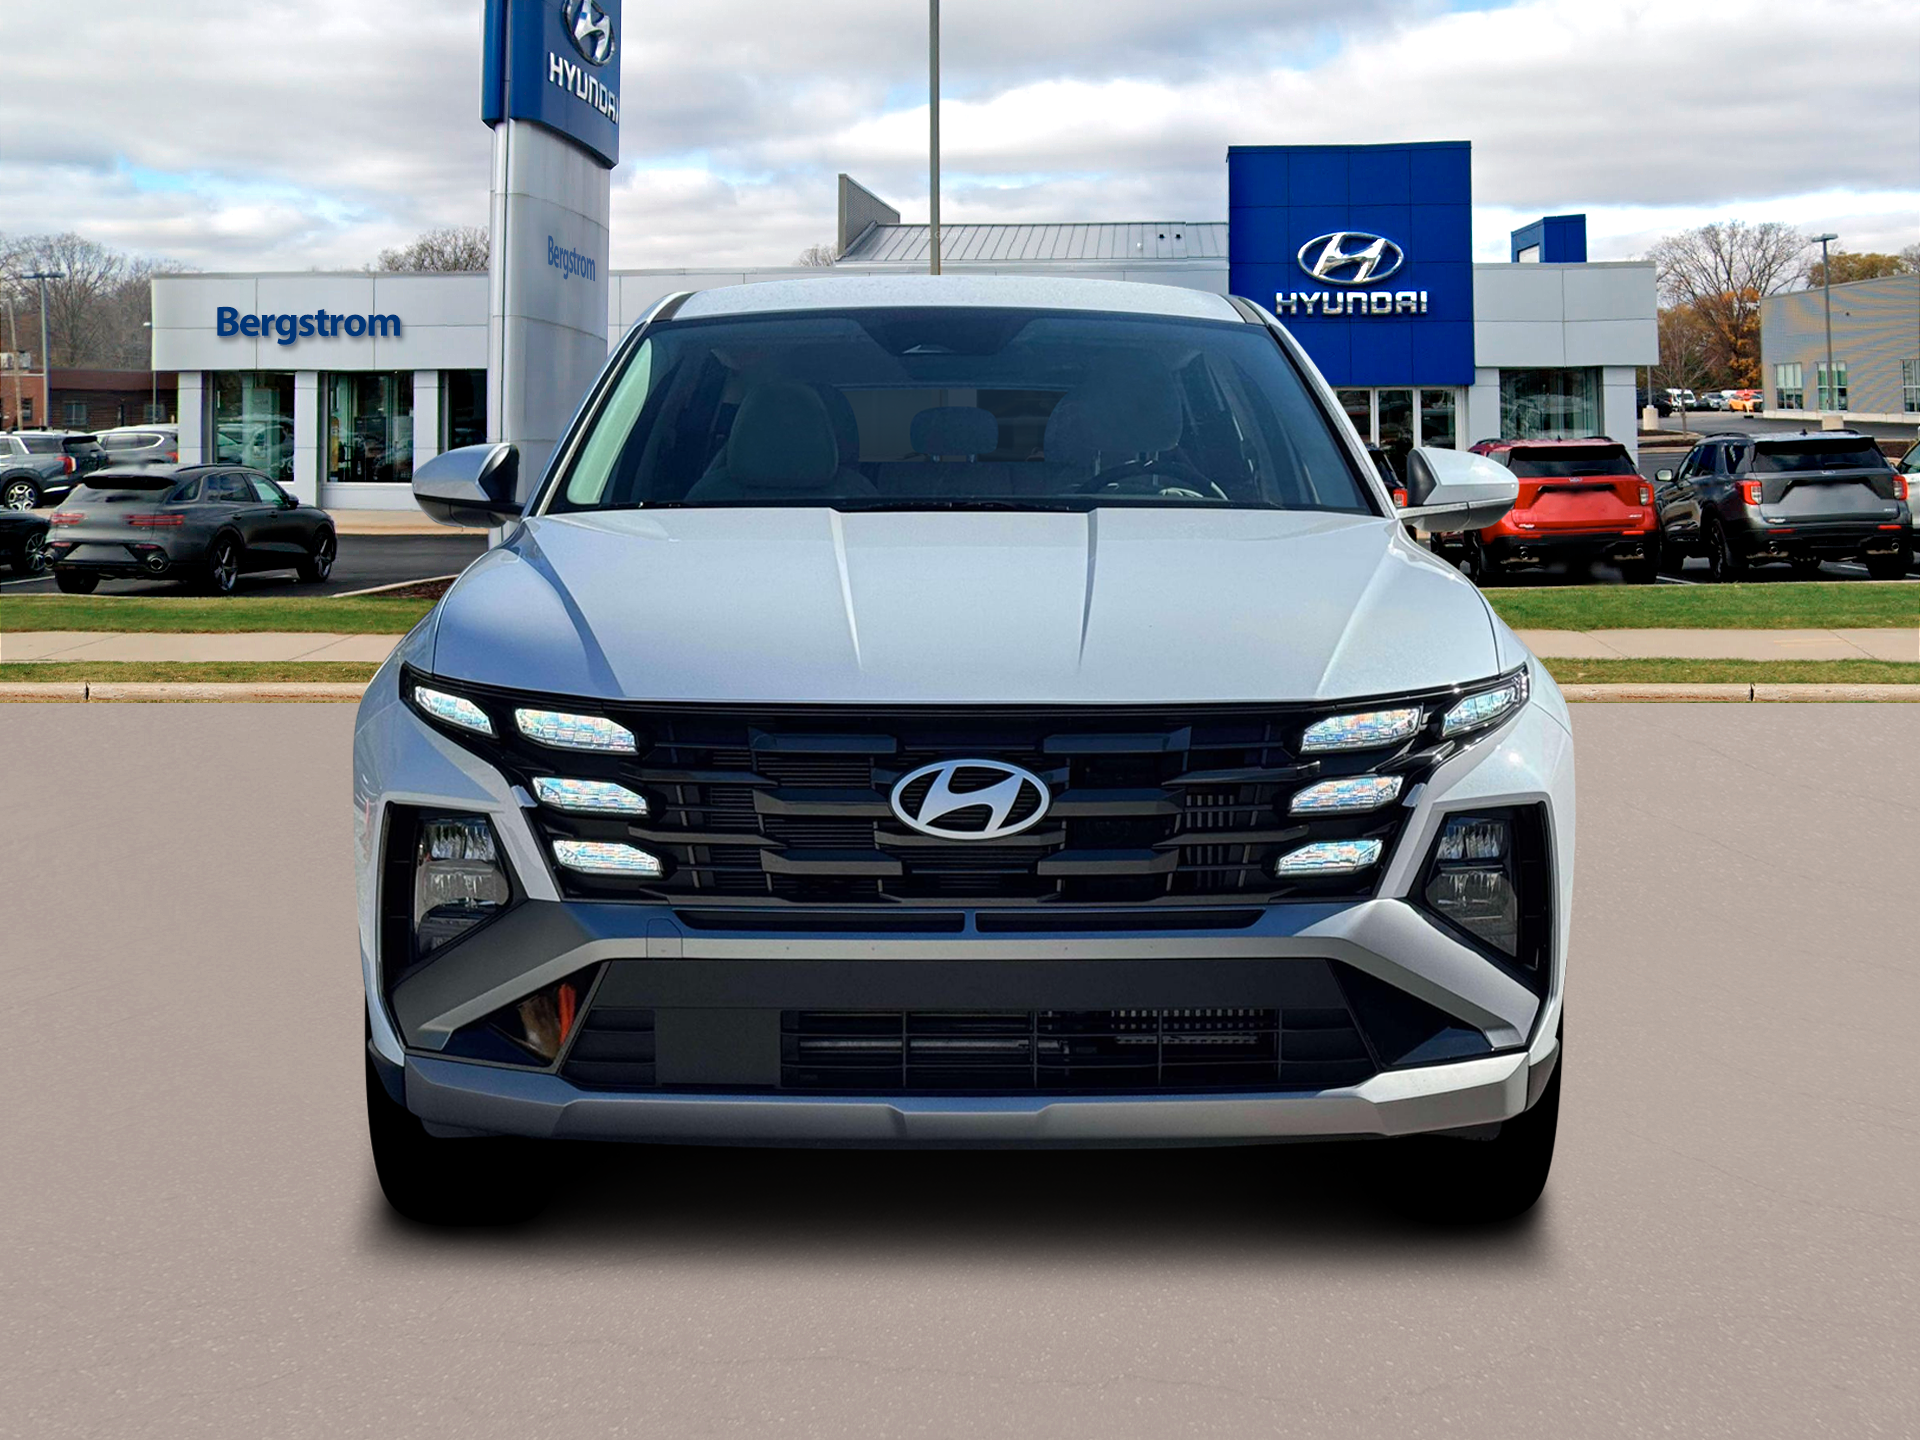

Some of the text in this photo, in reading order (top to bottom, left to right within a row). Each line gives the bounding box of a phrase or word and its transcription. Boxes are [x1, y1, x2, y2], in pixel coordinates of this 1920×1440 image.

[549, 52, 619, 124] HYUNDAI
[548, 235, 596, 282] Bergstrom
[1276, 291, 1428, 315] HYUNDAI
[217, 306, 401, 346] Bergstrom
